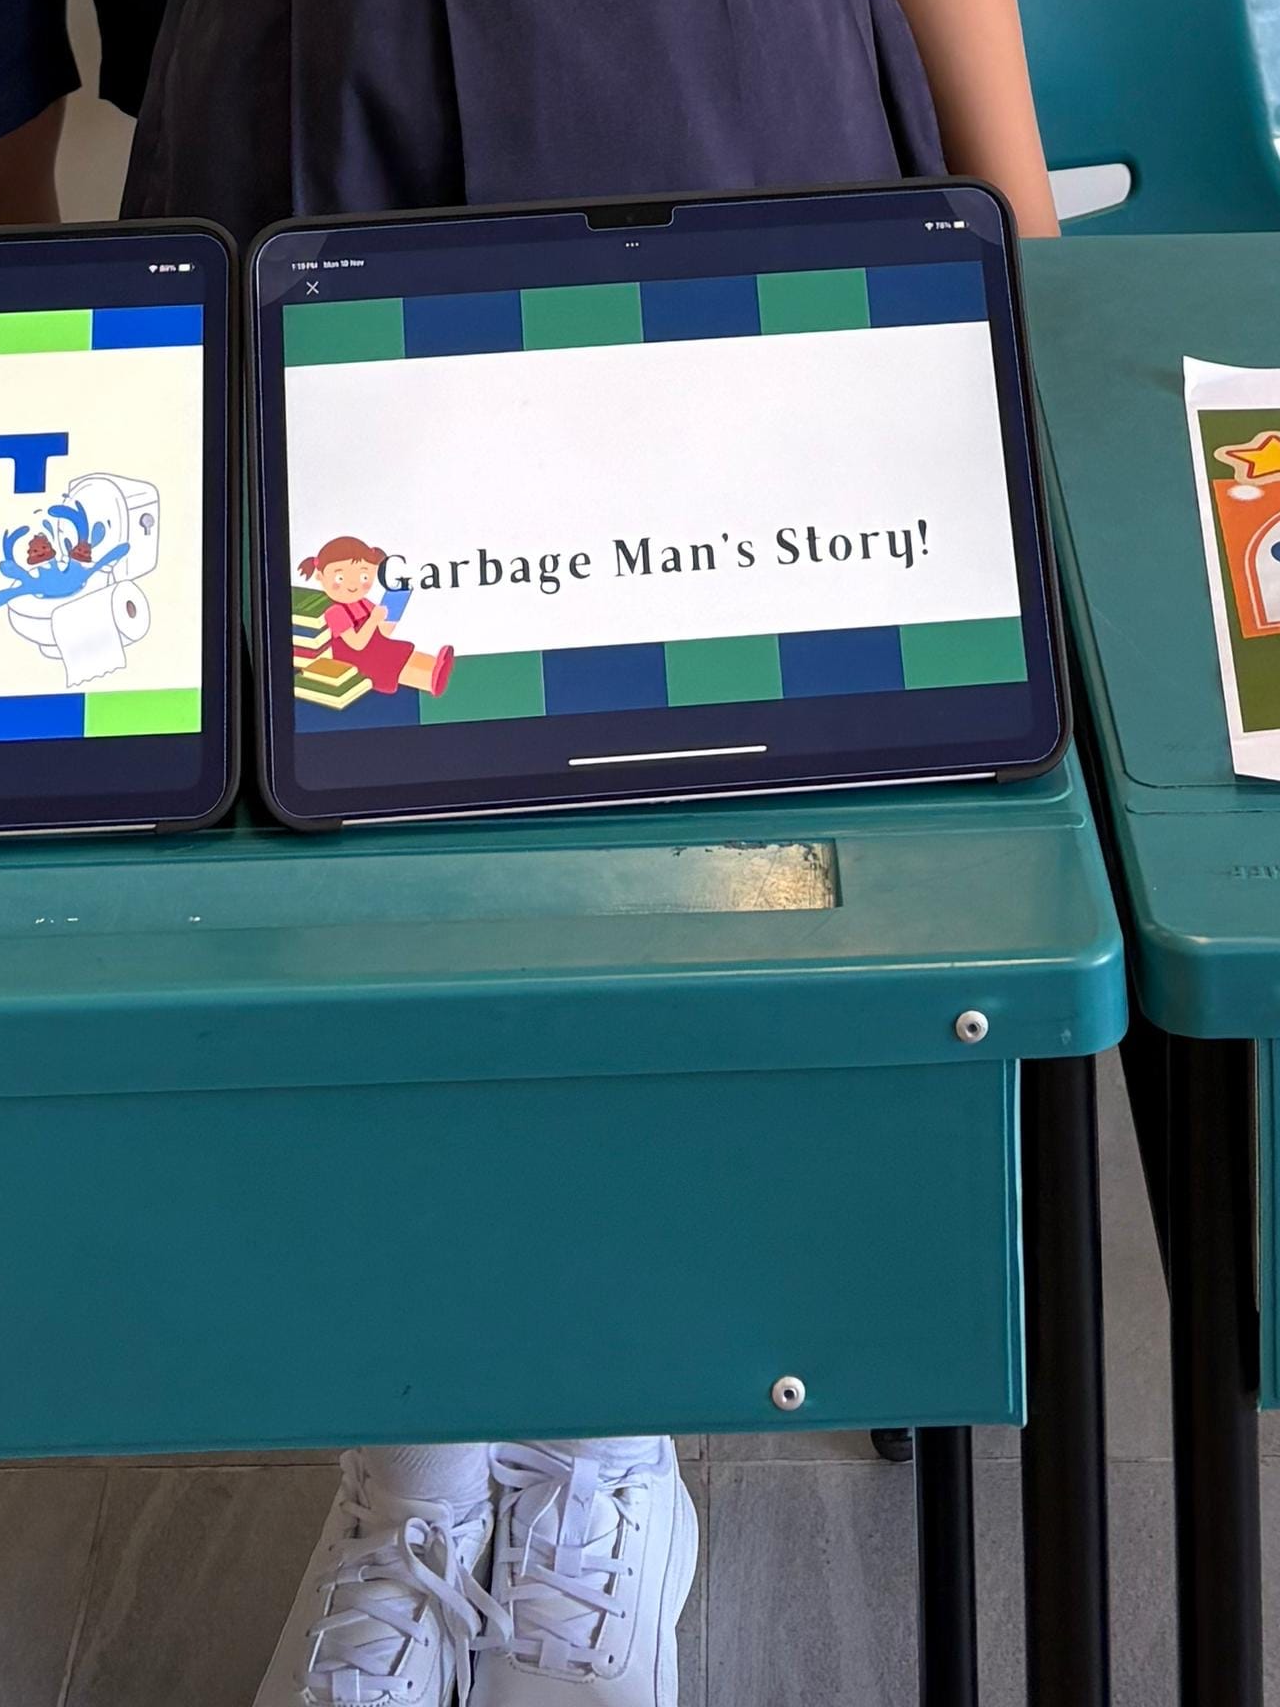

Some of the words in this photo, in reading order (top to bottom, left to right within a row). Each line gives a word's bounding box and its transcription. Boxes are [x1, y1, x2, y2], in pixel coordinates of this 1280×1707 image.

[377, 547, 591, 595] Garbage
[613, 533, 756, 578] Man's
[776, 520, 931, 569] Story!
